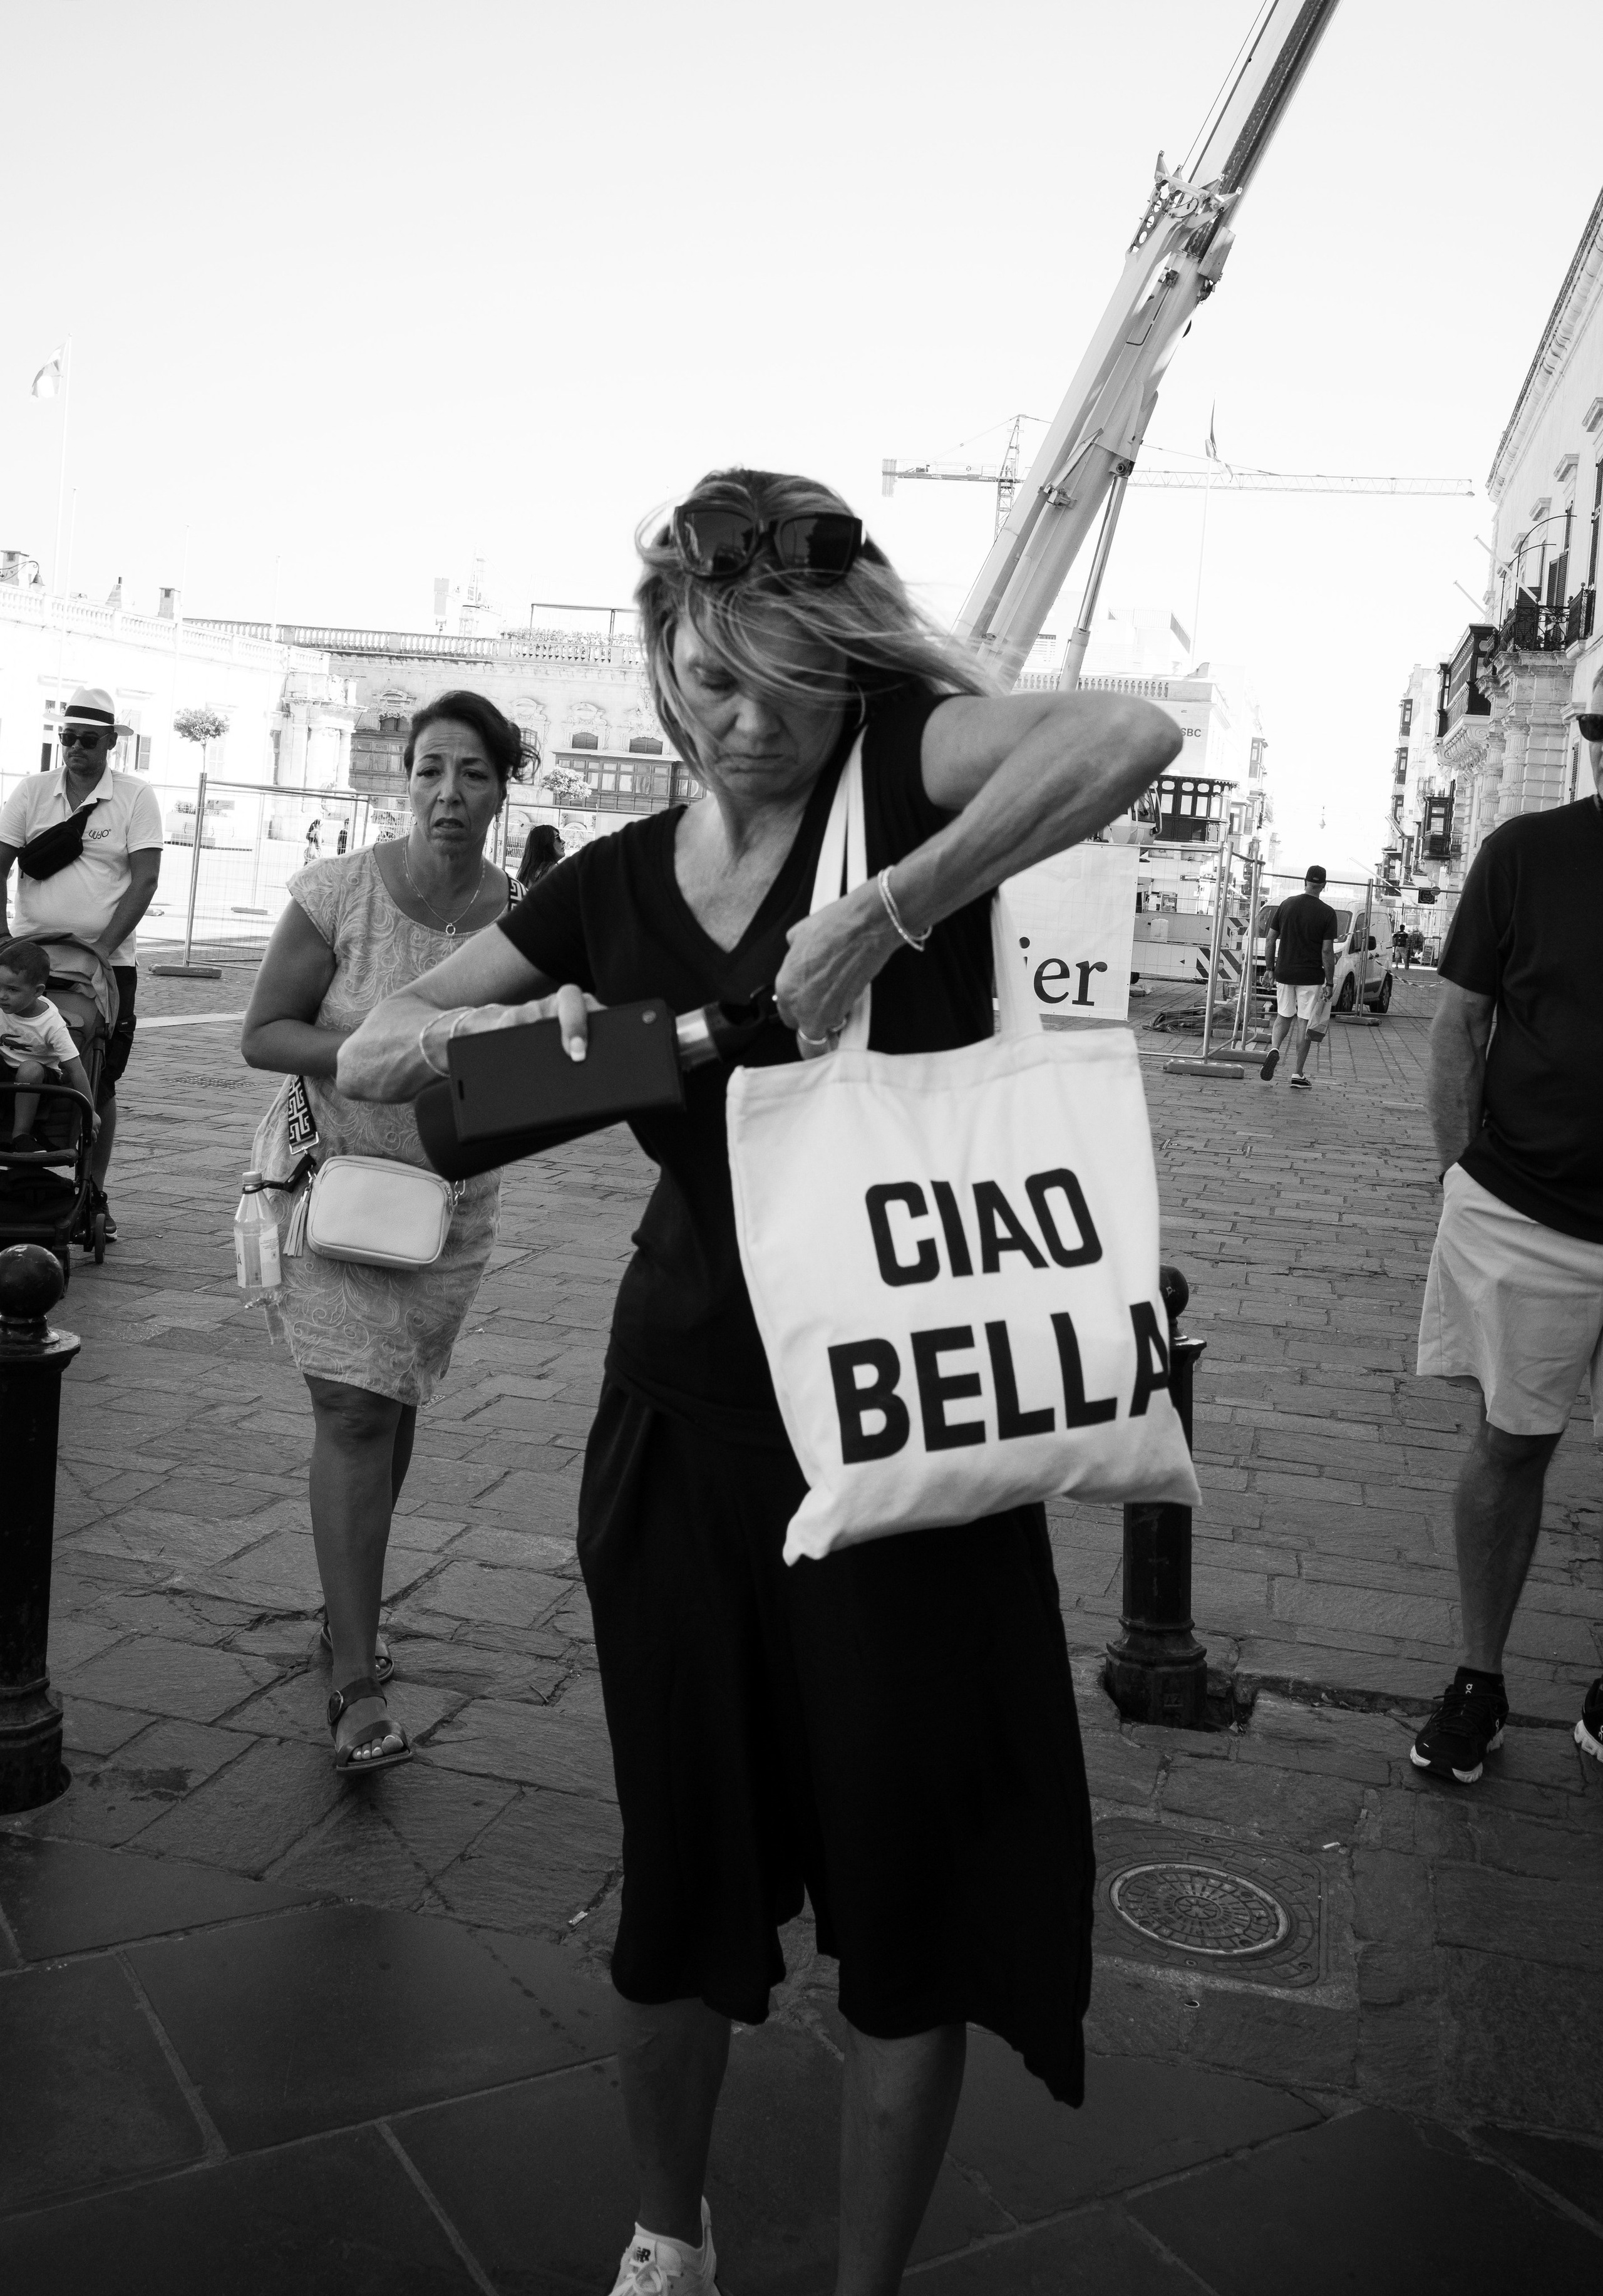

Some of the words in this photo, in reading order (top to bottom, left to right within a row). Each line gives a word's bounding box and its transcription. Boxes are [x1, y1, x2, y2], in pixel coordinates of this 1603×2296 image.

[1181, 728, 1202, 737] SBC
[865, 1167, 1103, 1287] CIAO
[827, 1301, 1169, 1465] BELLA
